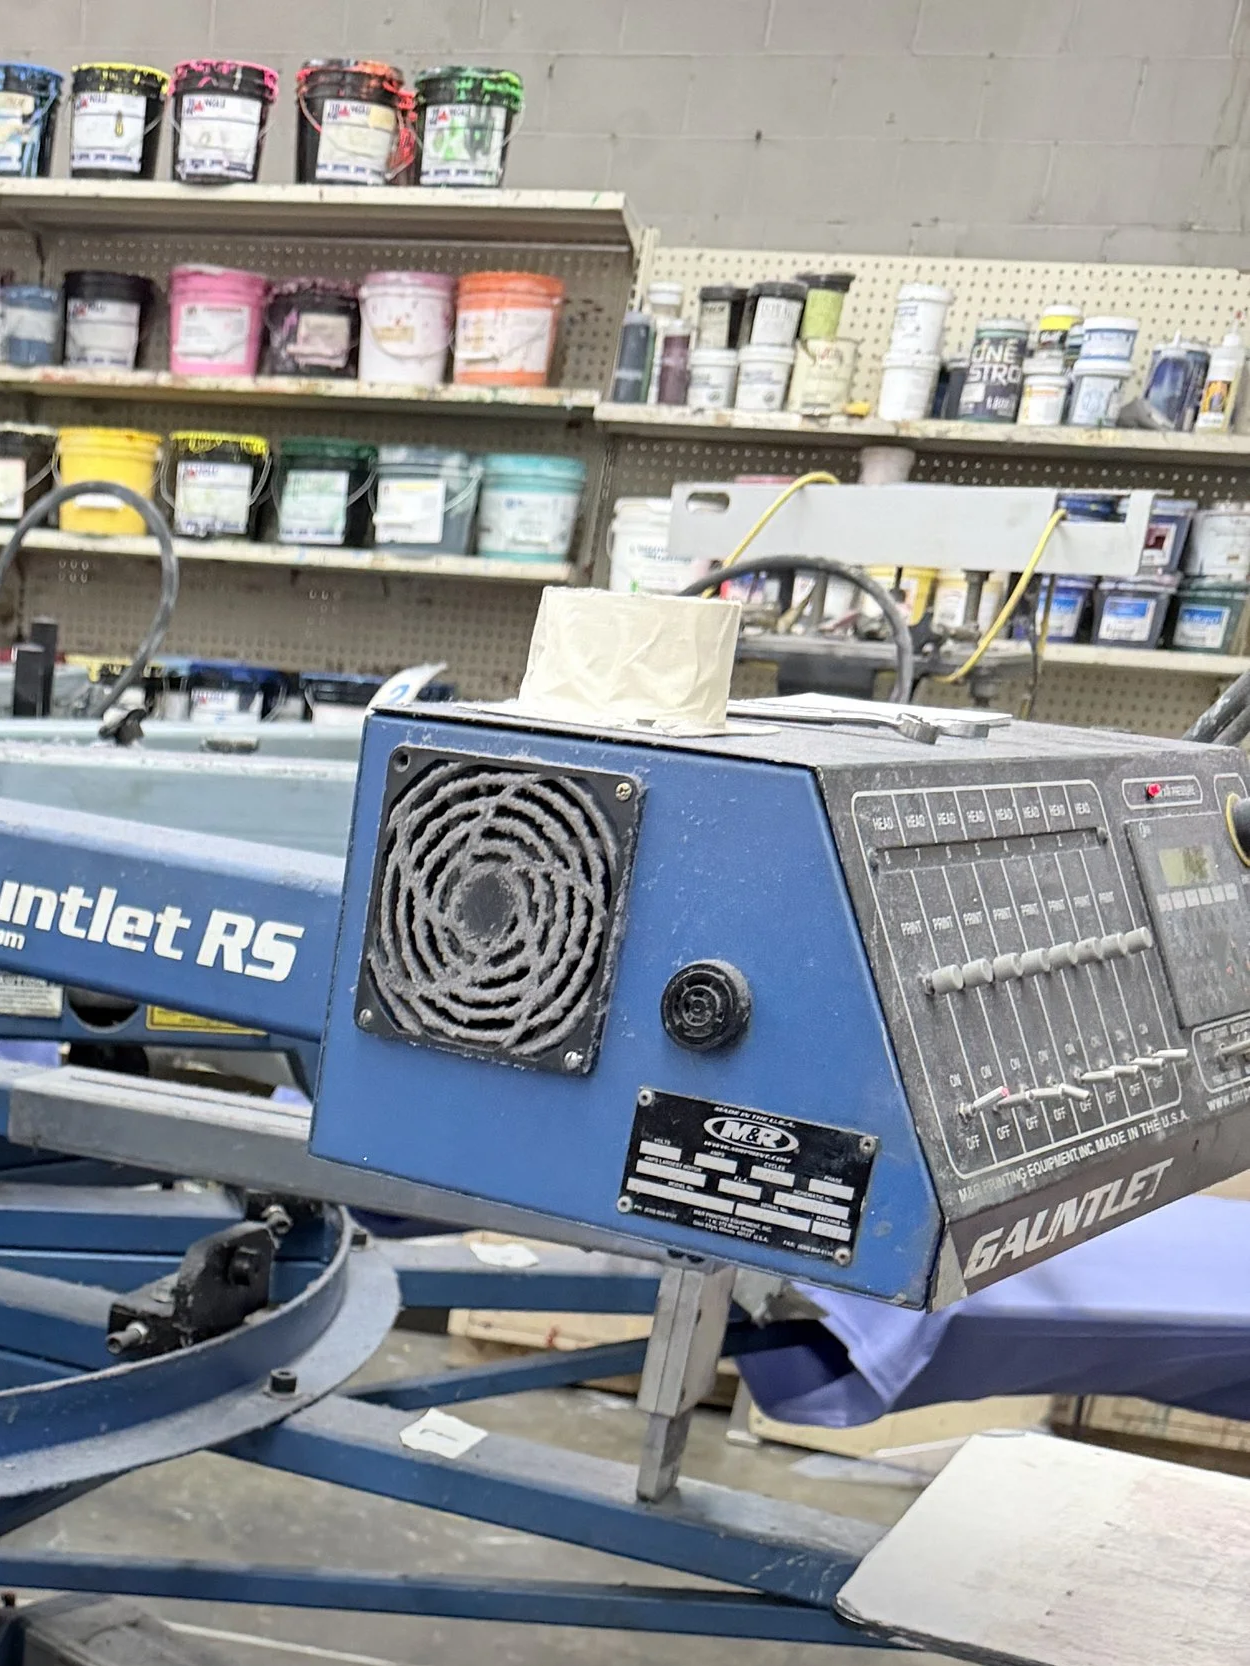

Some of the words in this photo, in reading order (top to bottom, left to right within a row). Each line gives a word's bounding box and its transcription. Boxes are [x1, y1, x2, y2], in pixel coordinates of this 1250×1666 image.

[971, 339, 1018, 363] ONE
[872, 817, 894, 831] HEAD
[905, 814, 926, 828] HEAD
[937, 812, 956, 826] HEAD
[966, 809, 986, 823] HEAD
[995, 807, 1014, 821] HEAD
[1022, 805, 1040, 819] HEAD
[1049, 803, 1065, 816] HEAD
[1074, 802, 1091, 815] HEAD
[900, 920, 922, 936] PRINT
[931, 916, 953, 931] PRINT
[962, 911, 983, 926] PRINT
[992, 906, 1012, 921] PRINT
[1020, 902, 1039, 917] PRINT
[1047, 899, 1065, 912] PRINT
[1073, 894, 1091, 908] PRINT
[1098, 891, 1114, 904] PRINT
[196, 909, 305, 982] RS
[949, 1072, 962, 1087] ON
[980, 1064, 992, 1079] ON
[1009, 1056, 1021, 1070] ON
[714, 1106, 740, 1116] MADE
[752, 1114, 768, 1123] THE
[966, 1134, 981, 1151] OFF
[996, 1124, 1011, 1141] OFF
[1025, 1116, 1040, 1131] OFF
[1053, 1106, 1067, 1122] OFF
[1079, 1098, 1093, 1113] OFF
[1104, 1090, 1118, 1104] OFF
[1129, 1082, 1143, 1097] OFF
[719, 1120, 782, 1148] M&R
[763, 1161, 786, 1172] CYCLES
[958, 1184, 982, 1203] M&R
[982, 1167, 1027, 1195] PRINTING
[1095, 1132, 1126, 1153] MADE
[1127, 1127, 1139, 1141] IN
[1139, 1121, 1161, 1137] THE
[1160, 1109, 1190, 1129] U.S.A.
[823, 1175, 843, 1184] PHASE
[963, 1157, 1175, 1280] GAUNTLET
